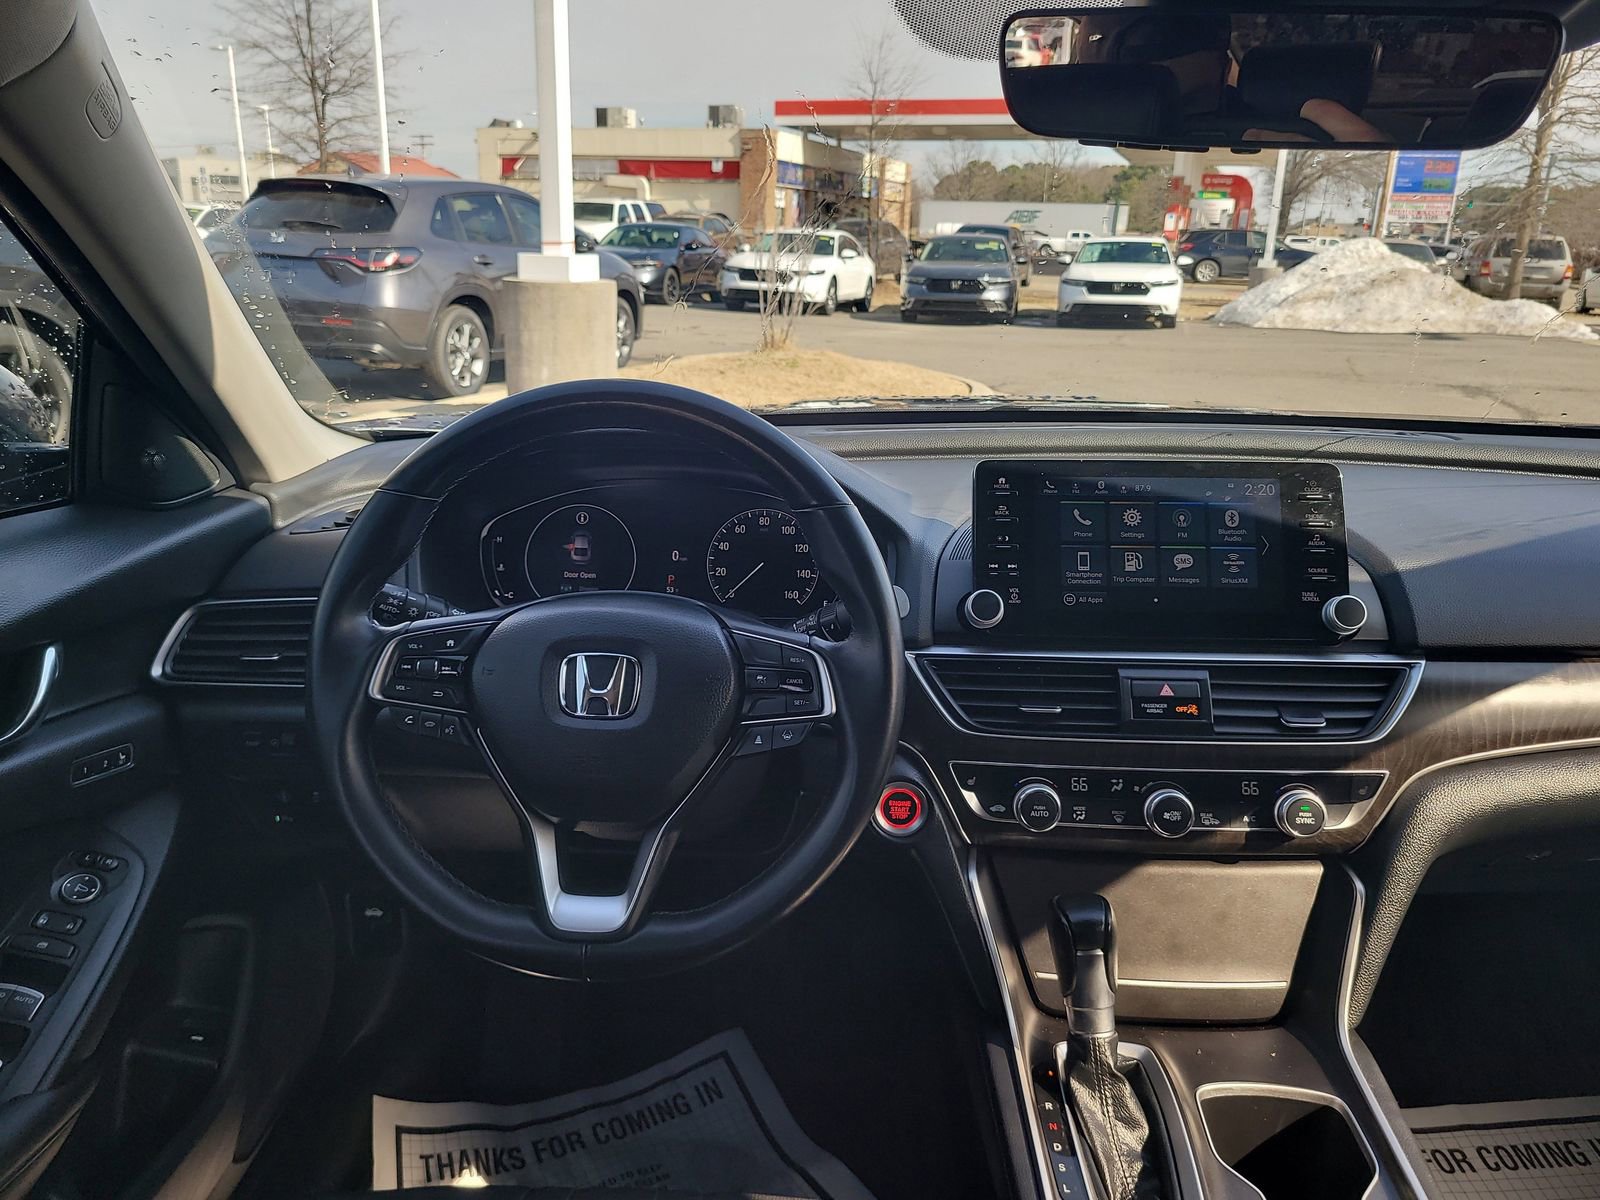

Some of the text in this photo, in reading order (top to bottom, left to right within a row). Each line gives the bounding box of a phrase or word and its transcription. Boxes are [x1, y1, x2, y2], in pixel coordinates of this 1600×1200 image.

[93, 93, 116, 131] AIRBAG
[1134, 484, 1152, 492] 87.9
[1244, 482, 1276, 496] 2:20
[758, 516, 770, 526] 80
[734, 524, 746, 534] 60
[781, 526, 796, 535] 100
[1218, 528, 1247, 536] Bluetooth
[1120, 531, 1145, 539] Settings
[718, 541, 730, 551] 40
[794, 543, 809, 553] 120
[671, 550, 680, 561] 0
[1175, 557, 1192, 566] SMS
[579, 571, 597, 579] Open
[715, 567, 727, 576] 20
[796, 569, 811, 579] 140
[1065, 571, 1103, 579] Smartphone
[667, 574, 675, 585] P
[1113, 576, 1156, 584] Trip Computer
[1168, 577, 1200, 585] Messages
[1221, 577, 1249, 585] SiriusXM
[784, 590, 799, 600] 160
[379, 604, 398, 614] AUTO
[1175, 705, 1188, 713] OFF
[1071, 777, 1088, 792] 66
[1241, 781, 1260, 796] 66
[888, 799, 912, 807] ENGINE
[1030, 810, 1049, 818] AUTO
[1295, 817, 1316, 825] SYNC
[14, 995, 35, 1004] AUTO
[1044, 1101, 1054, 1111] R
[419, 1078, 723, 1184] THANKS FOR COMING IN
[1047, 1122, 1058, 1131] N
[1052, 1142, 1062, 1152] D
[1475, 1139, 1592, 1172] COMING
[1058, 1163, 1067, 1172] S
[1062, 1184, 1071, 1193] L
